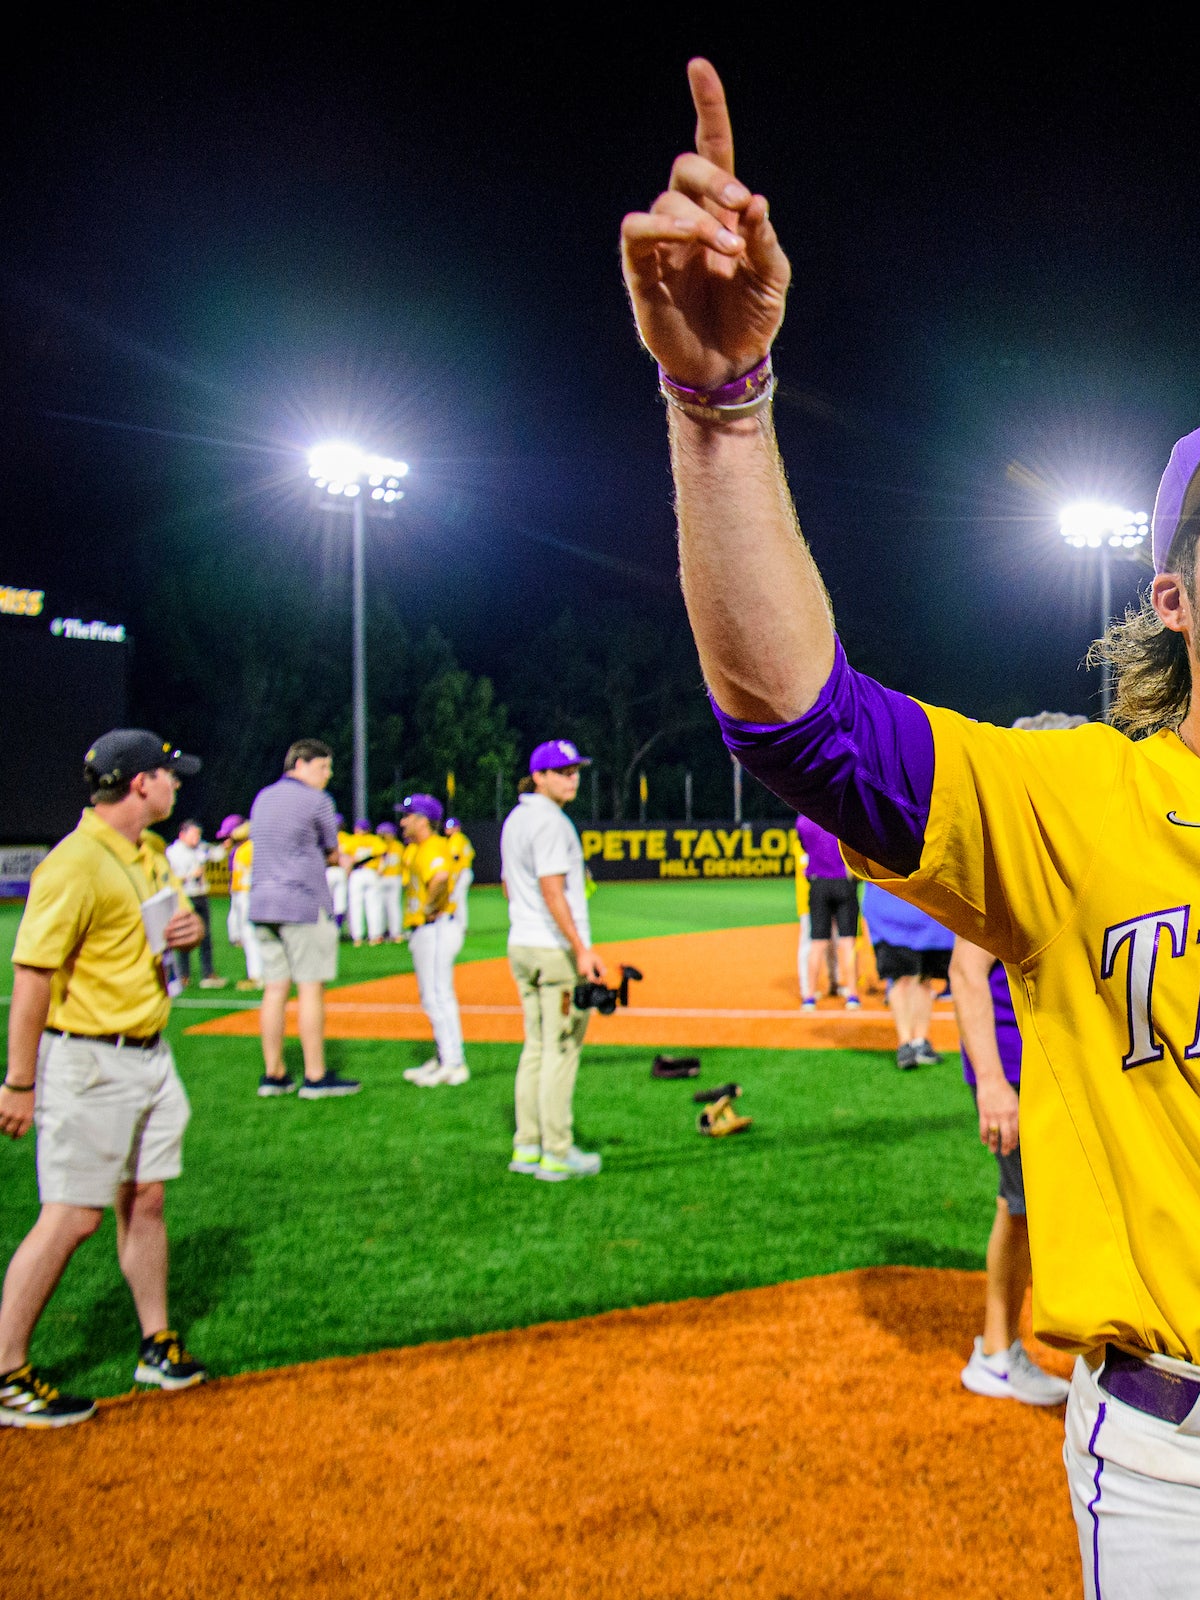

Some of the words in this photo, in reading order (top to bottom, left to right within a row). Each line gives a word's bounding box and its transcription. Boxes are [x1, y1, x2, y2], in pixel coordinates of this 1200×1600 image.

[581, 829, 667, 861] PETE
[660, 859, 700, 877] HILL
[703, 858, 781, 877] DENSON
